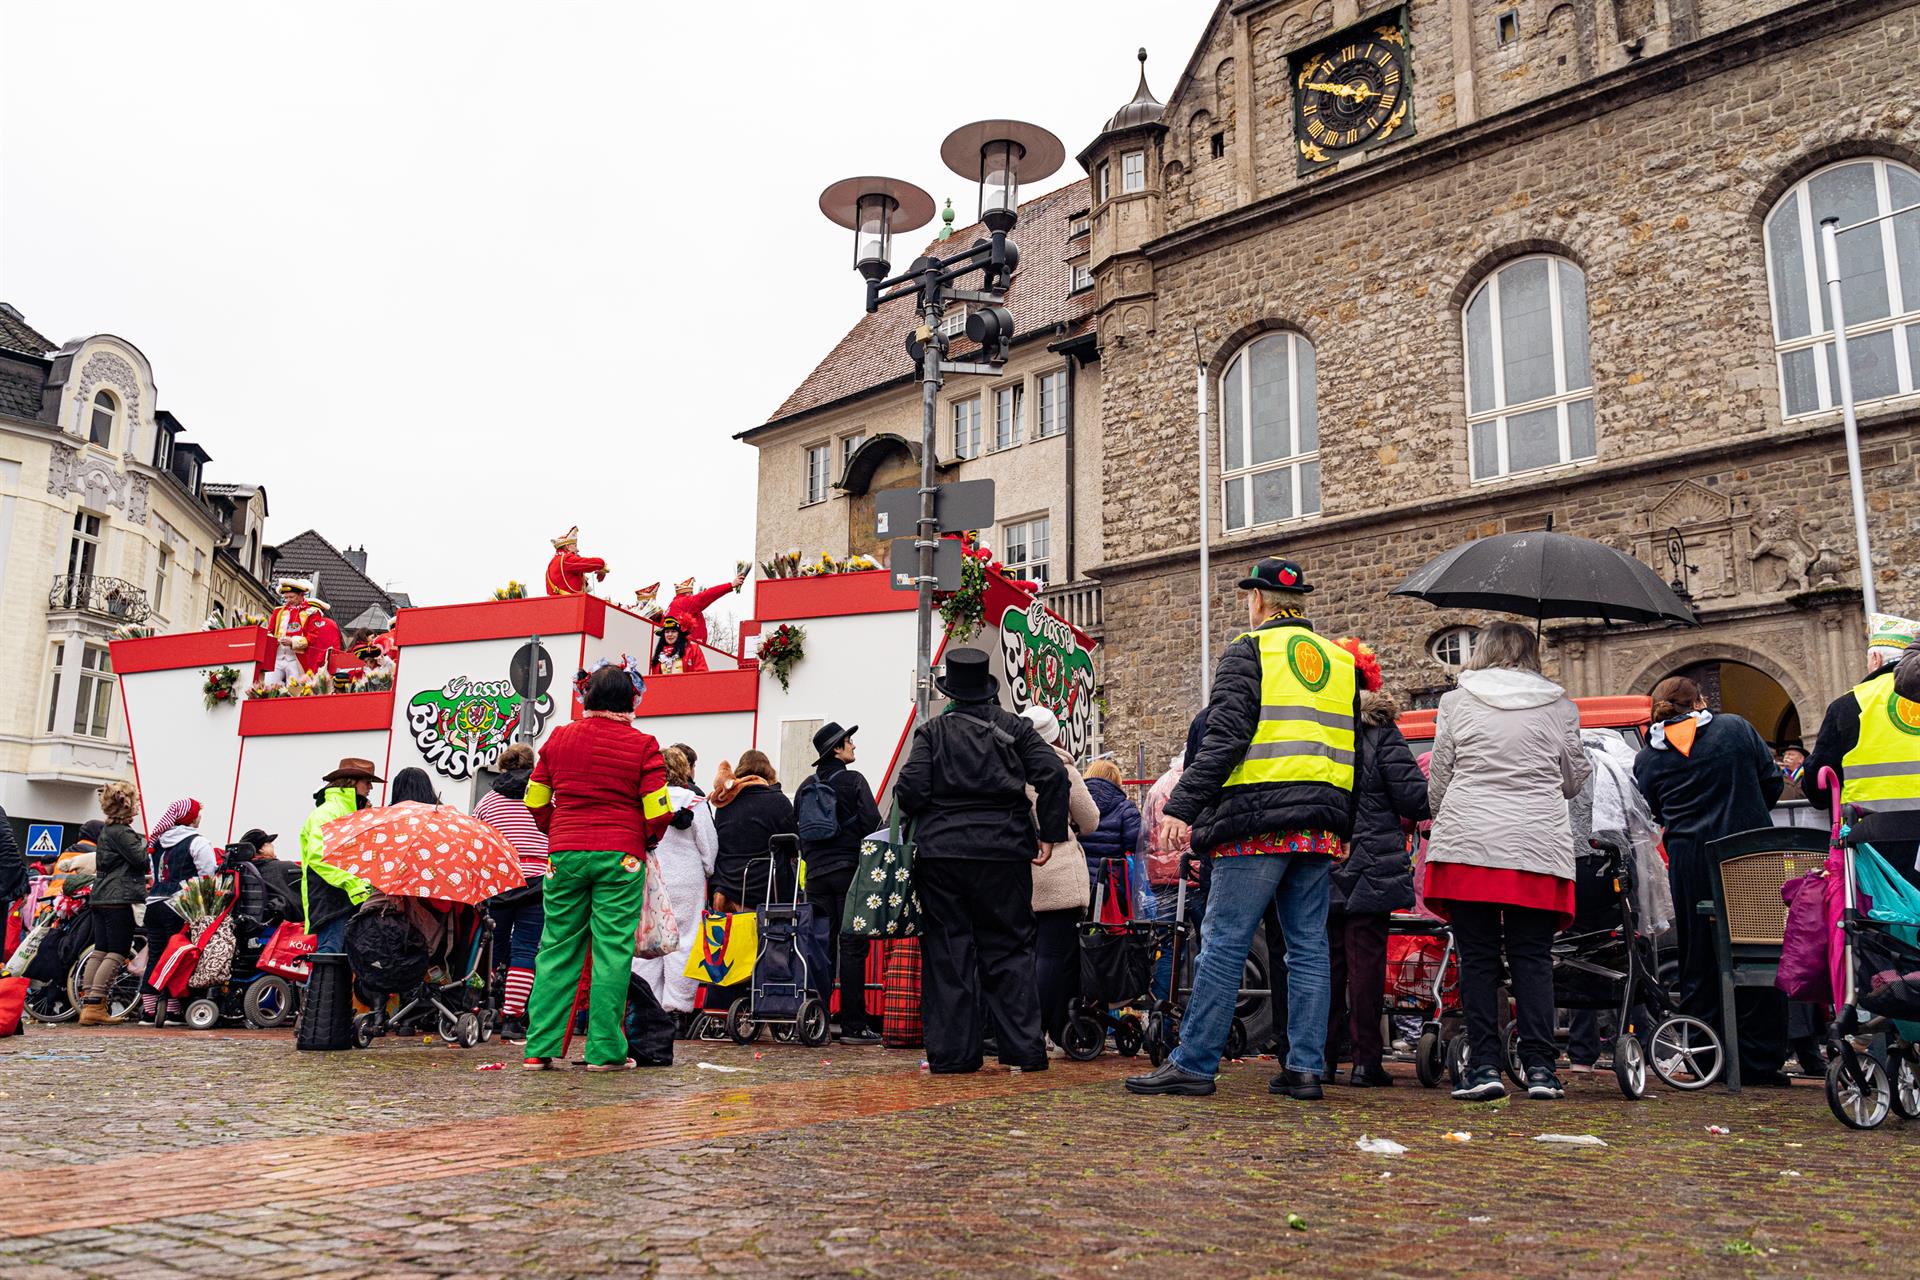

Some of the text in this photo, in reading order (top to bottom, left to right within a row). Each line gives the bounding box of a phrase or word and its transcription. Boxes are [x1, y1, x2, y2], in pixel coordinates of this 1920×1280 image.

[1027, 602, 1075, 655] Grosse
[442, 675, 517, 701] Grosse
[1003, 626, 1094, 757] Beerger
[289, 940, 315, 952] KÖLN
